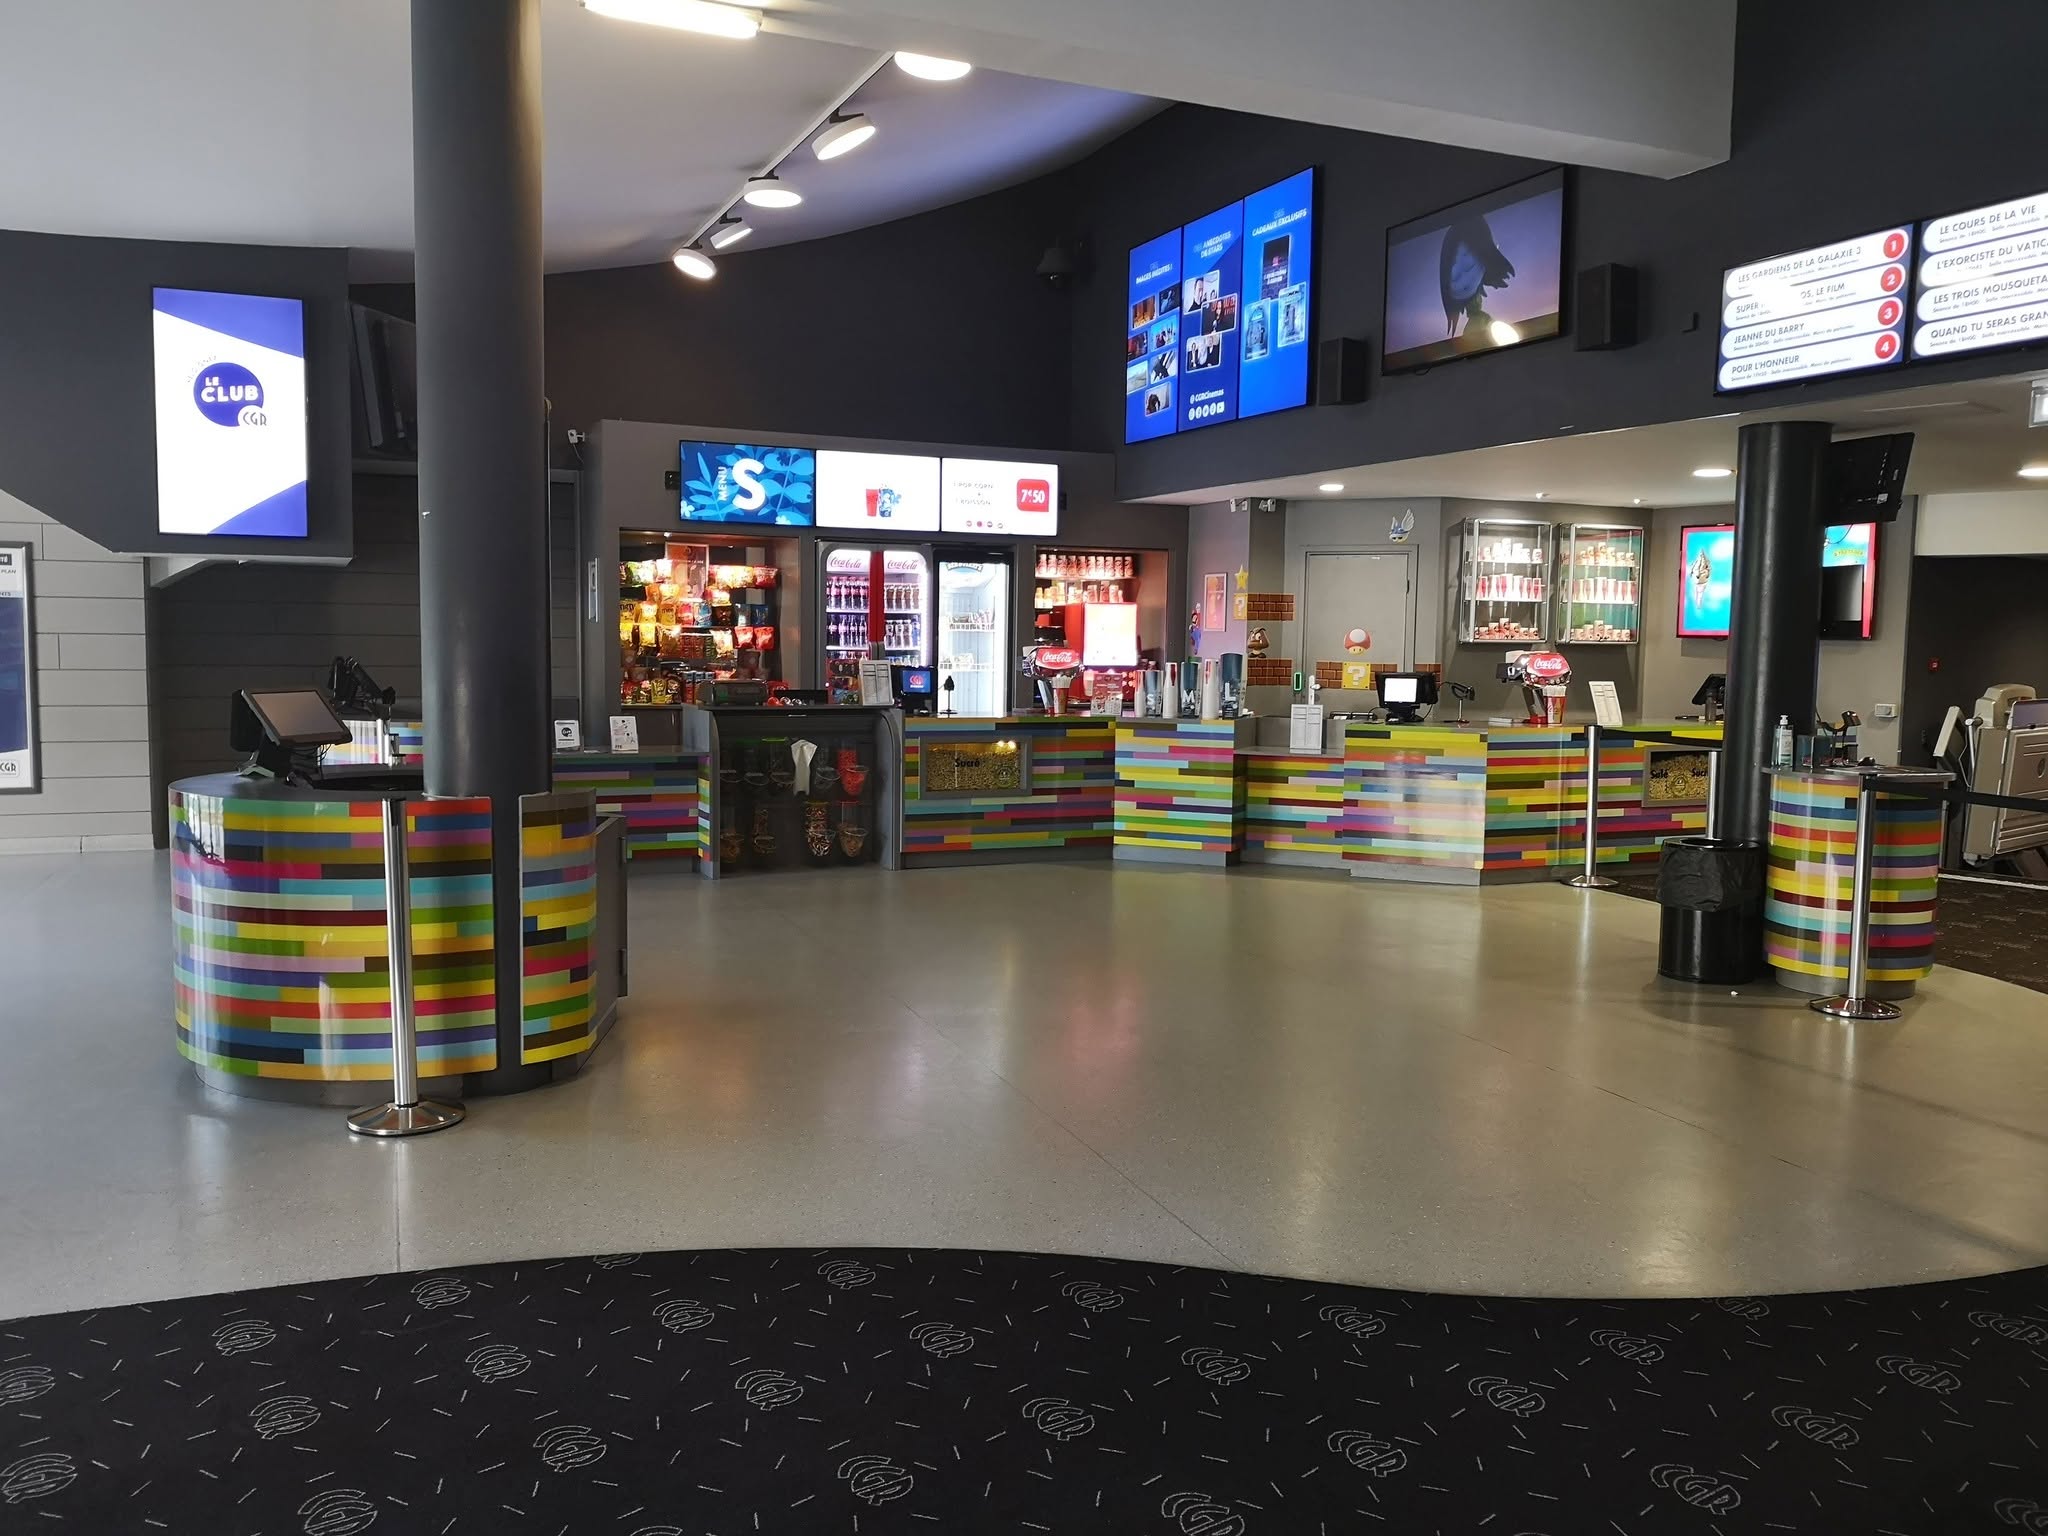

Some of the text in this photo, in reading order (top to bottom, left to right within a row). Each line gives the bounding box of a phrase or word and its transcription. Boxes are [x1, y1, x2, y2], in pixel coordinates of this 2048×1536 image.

[1252, 208, 1307, 237] CADEAUX EXCLUSIFS
[1940, 205, 2036, 235] LE COURS DE LA VIE
[1738, 274, 1750, 282] LES
[1752, 264, 1790, 280] GARDIENS
[1793, 261, 1802, 269] DE
[1806, 258, 1814, 266] LA
[1818, 249, 1852, 264] GALAXIE
[1891, 240, 1896, 251] 1
[1937, 250, 1995, 270] L'EXORCISTE
[1998, 246, 2013, 256] DU
[1736, 302, 1758, 313] SUPER
[1816, 287, 1824, 295] LE
[1827, 283, 1845, 293] FILM
[1887, 274, 1895, 286] 2
[1934, 294, 1948, 304] LES
[1952, 288, 1979, 300] TROIS
[1734, 307, 1892, 344] JEANNE DU BARRY 3
[1930, 325, 1967, 339] QUAND
[1971, 322, 1983, 331] TU
[1987, 316, 2017, 329] SERAS
[1732, 364, 1752, 374] POUR
[1755, 355, 1800, 370] L'HONNEUR
[1880, 341, 1889, 352] 4
[206, 377, 219, 386] LE
[201, 385, 259, 403] CLUB
[243, 411, 267, 426] CGR
[718, 466, 727, 501] MENU
[732, 458, 766, 510] S
[1182, 689, 1195, 703] M
[954, 758, 980, 768] Sucré
[1650, 768, 1668, 779] Salé
